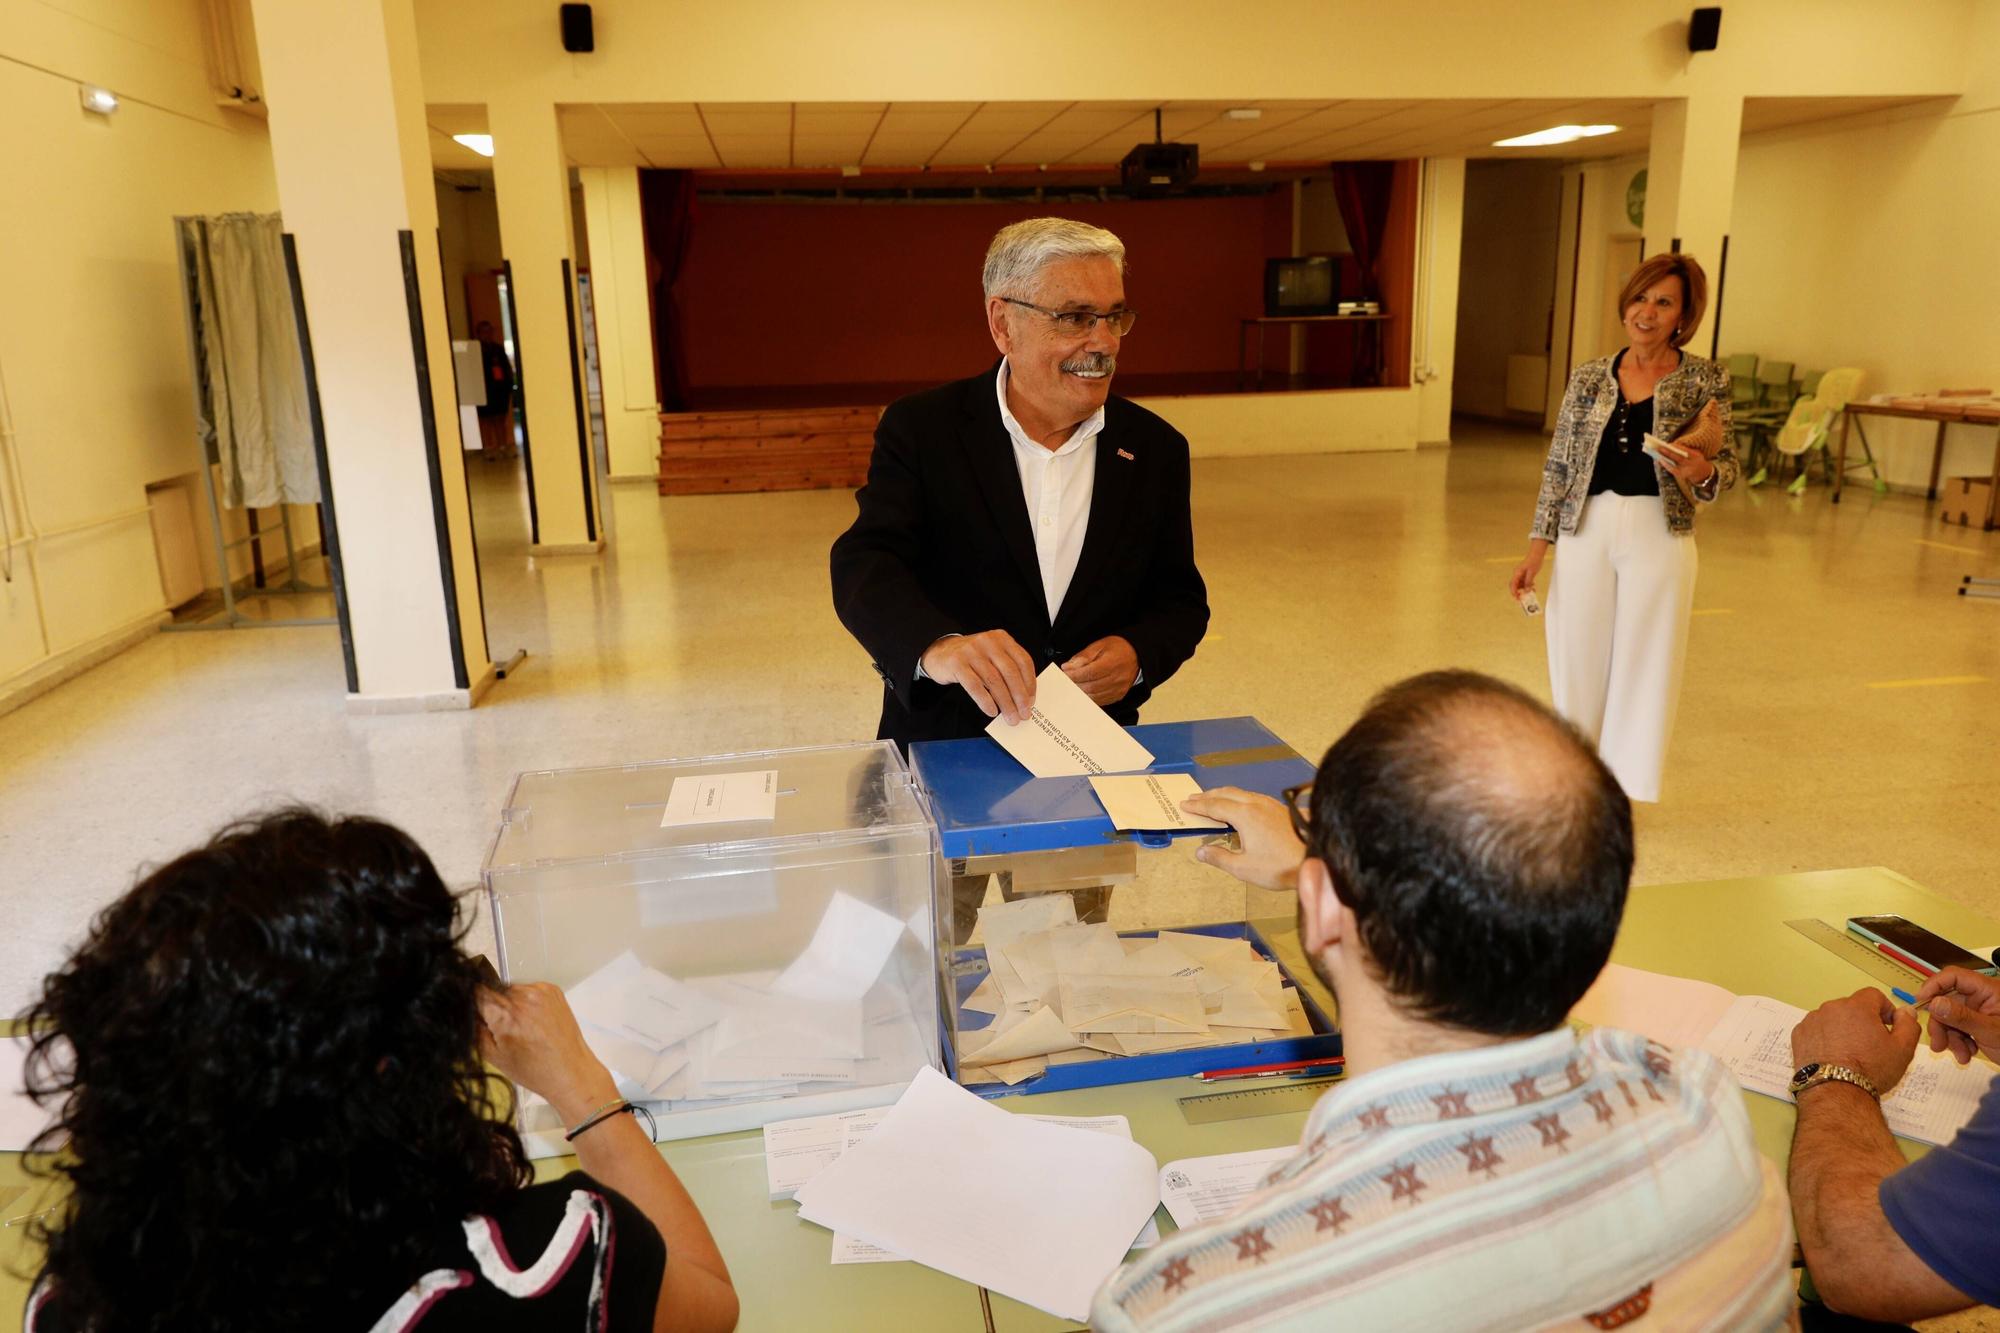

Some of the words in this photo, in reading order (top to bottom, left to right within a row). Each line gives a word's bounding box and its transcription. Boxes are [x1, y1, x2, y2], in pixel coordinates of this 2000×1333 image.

[1031, 714, 1054, 737] GENERA
[1043, 718, 1072, 743] ASTURIAS
[1053, 735, 1072, 753] JUNTA
[1070, 742, 1080, 752] DE
[1071, 751, 1080, 760] LA
